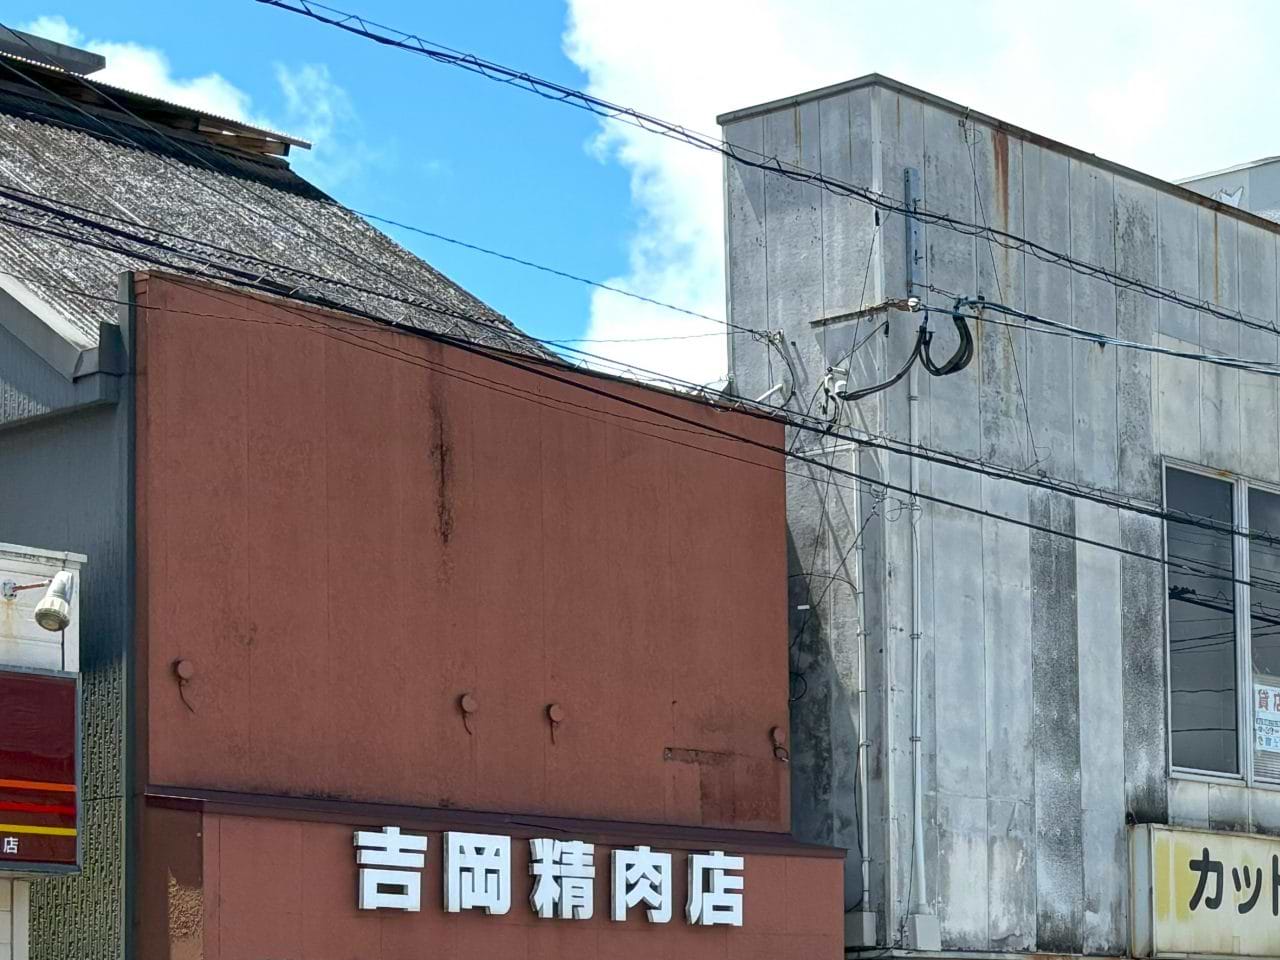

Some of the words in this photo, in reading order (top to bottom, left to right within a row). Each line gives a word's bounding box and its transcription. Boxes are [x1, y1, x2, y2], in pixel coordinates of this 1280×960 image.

[353, 826, 744, 927] 吉岡精肉店
